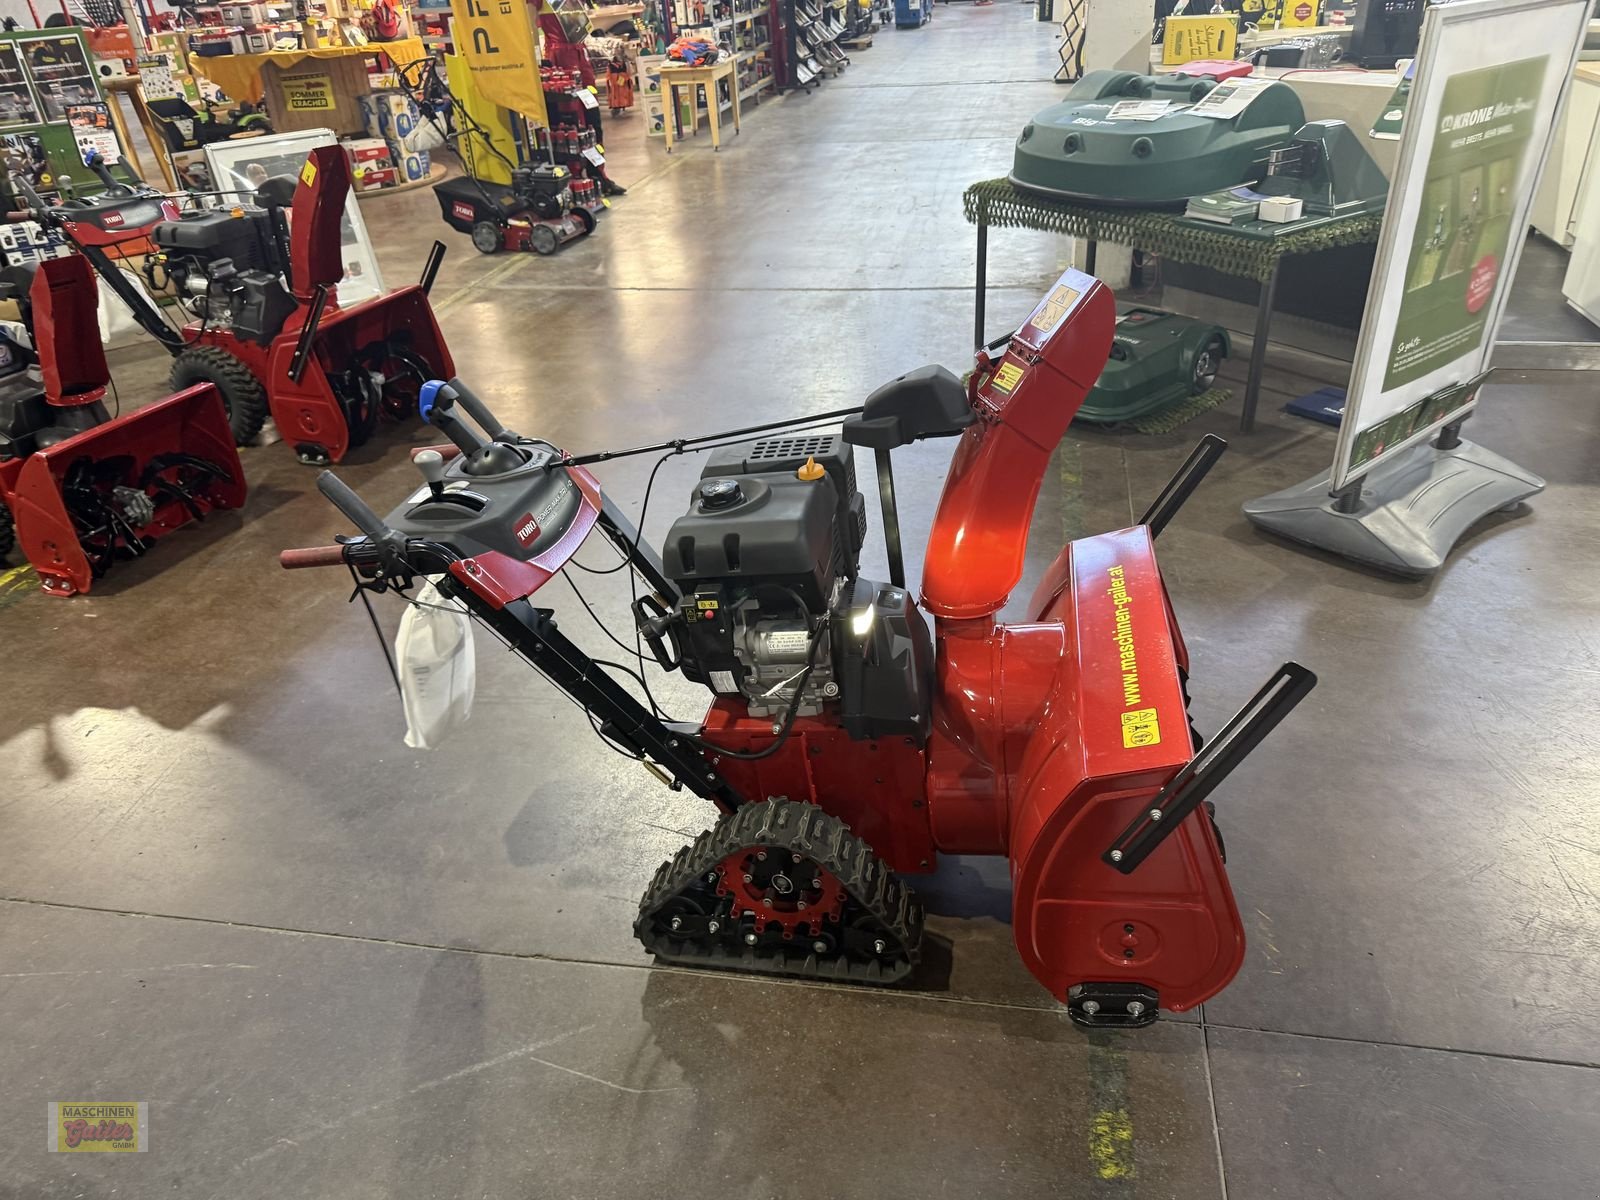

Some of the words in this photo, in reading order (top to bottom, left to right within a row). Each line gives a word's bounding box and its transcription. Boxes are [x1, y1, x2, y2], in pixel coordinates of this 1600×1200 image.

[1452, 106, 1495, 130] KRONE
[103, 214, 123, 224] TORO
[516, 520, 537, 541] TORO
[1107, 564, 1142, 707] www.maschinen-gailer.at
